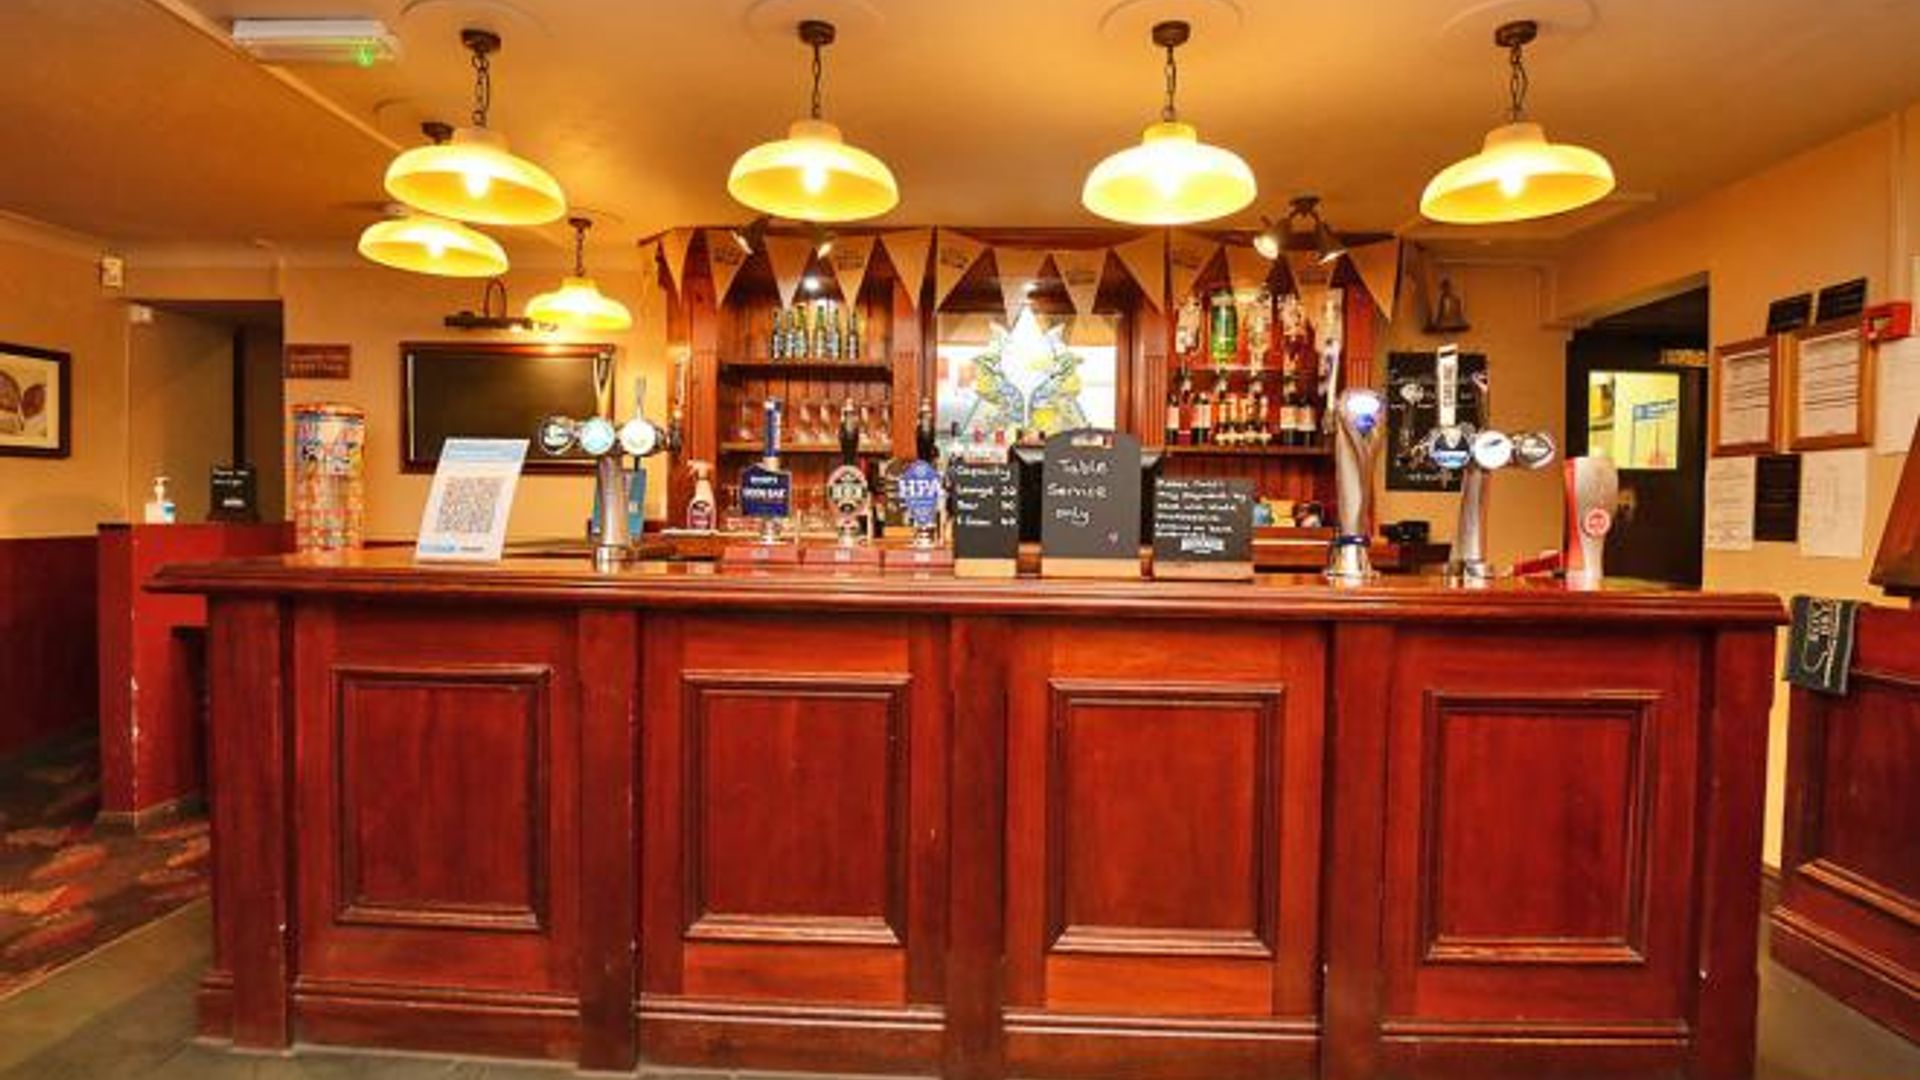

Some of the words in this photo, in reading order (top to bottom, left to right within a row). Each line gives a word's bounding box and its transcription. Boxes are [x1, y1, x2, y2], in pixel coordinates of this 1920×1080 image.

[1057, 458, 1109, 476] Table
[898, 478, 943, 498] HPA
[1046, 482, 1108, 499] Service
[1053, 505, 1090, 527] only
